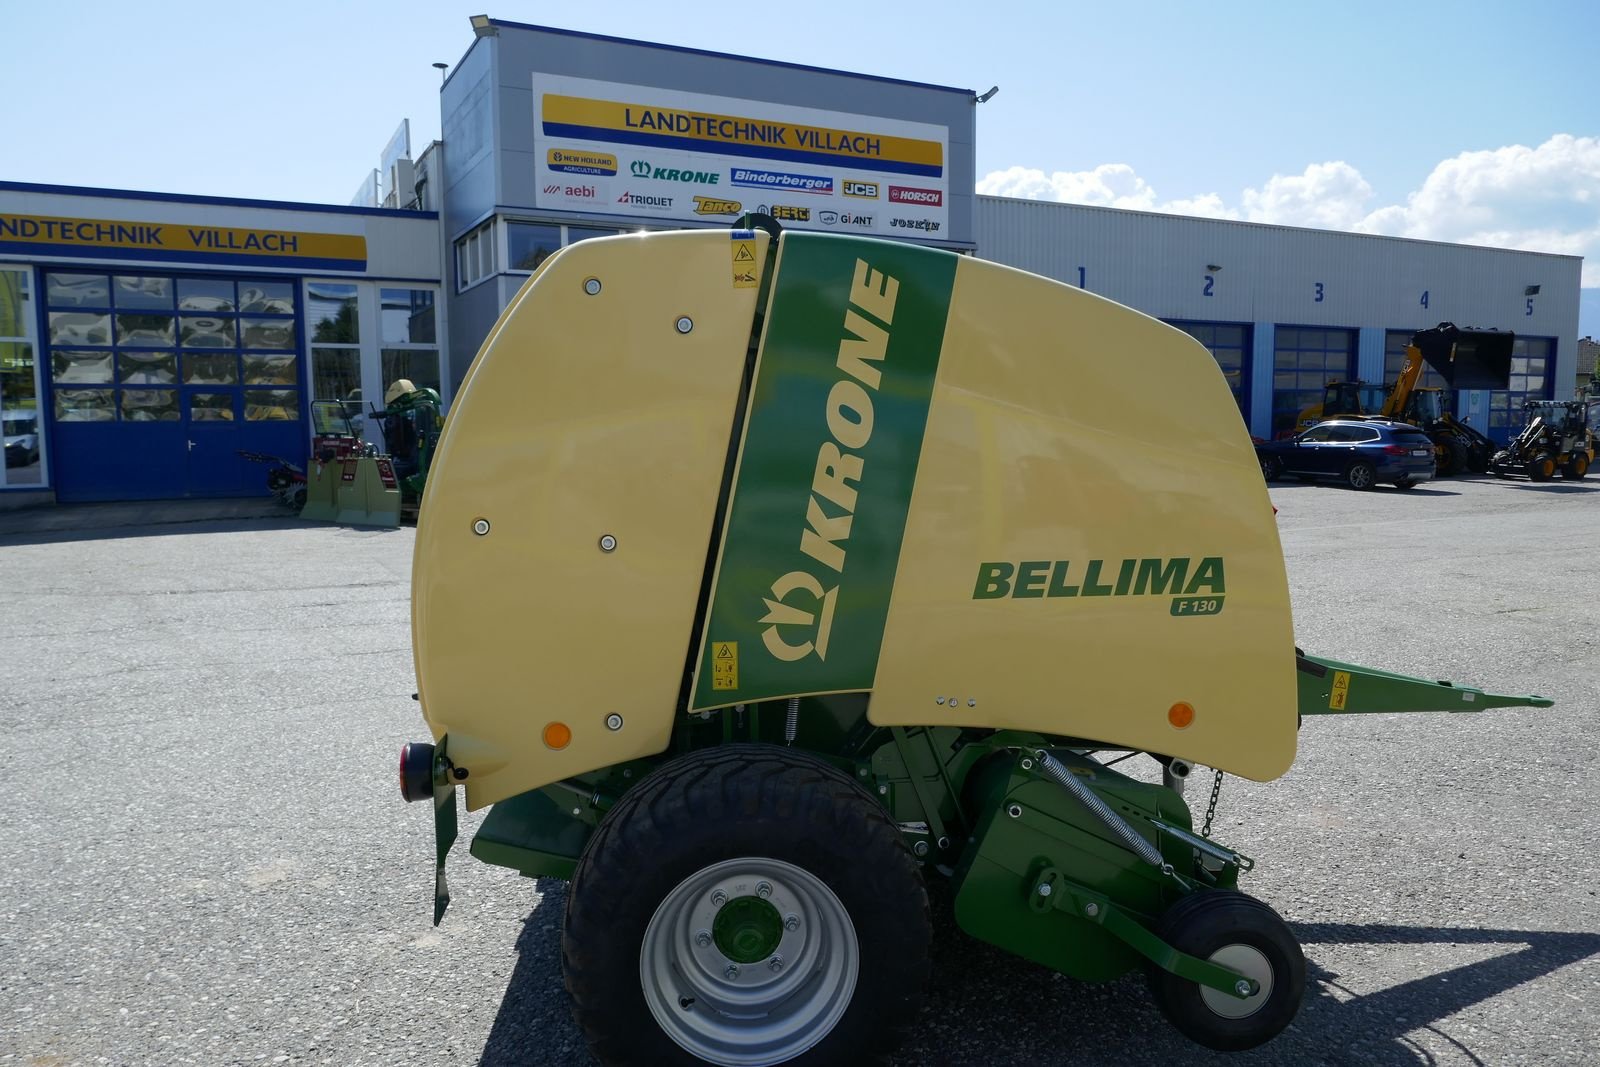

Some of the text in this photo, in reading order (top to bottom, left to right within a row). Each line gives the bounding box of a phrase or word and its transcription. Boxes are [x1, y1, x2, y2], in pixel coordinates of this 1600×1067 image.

[625, 108, 881, 155] LANDTECHNIK VILLACH
[563, 155, 612, 166] NEW HOLLAND
[563, 166, 602, 175] AGRICULTURE
[653, 167, 720, 185] KRONE
[734, 170, 831, 189] Binderberger
[565, 185, 595, 198] aebi
[844, 182, 877, 197] JCB
[899, 190, 940, 203] HORSCH
[629, 194, 674, 207] TRIOLIET
[188, 229, 298, 253] VILLACH
[1078, 266, 1086, 289] 1
[1203, 276, 1214, 297] 2
[1314, 282, 1324, 302] 3
[1420, 290, 1429, 310] 4
[1525, 298, 1533, 316] 5
[800, 257, 900, 573] KRONE
[972, 556, 1226, 600] BELLIMA
[1178, 599, 1217, 613] F 130
